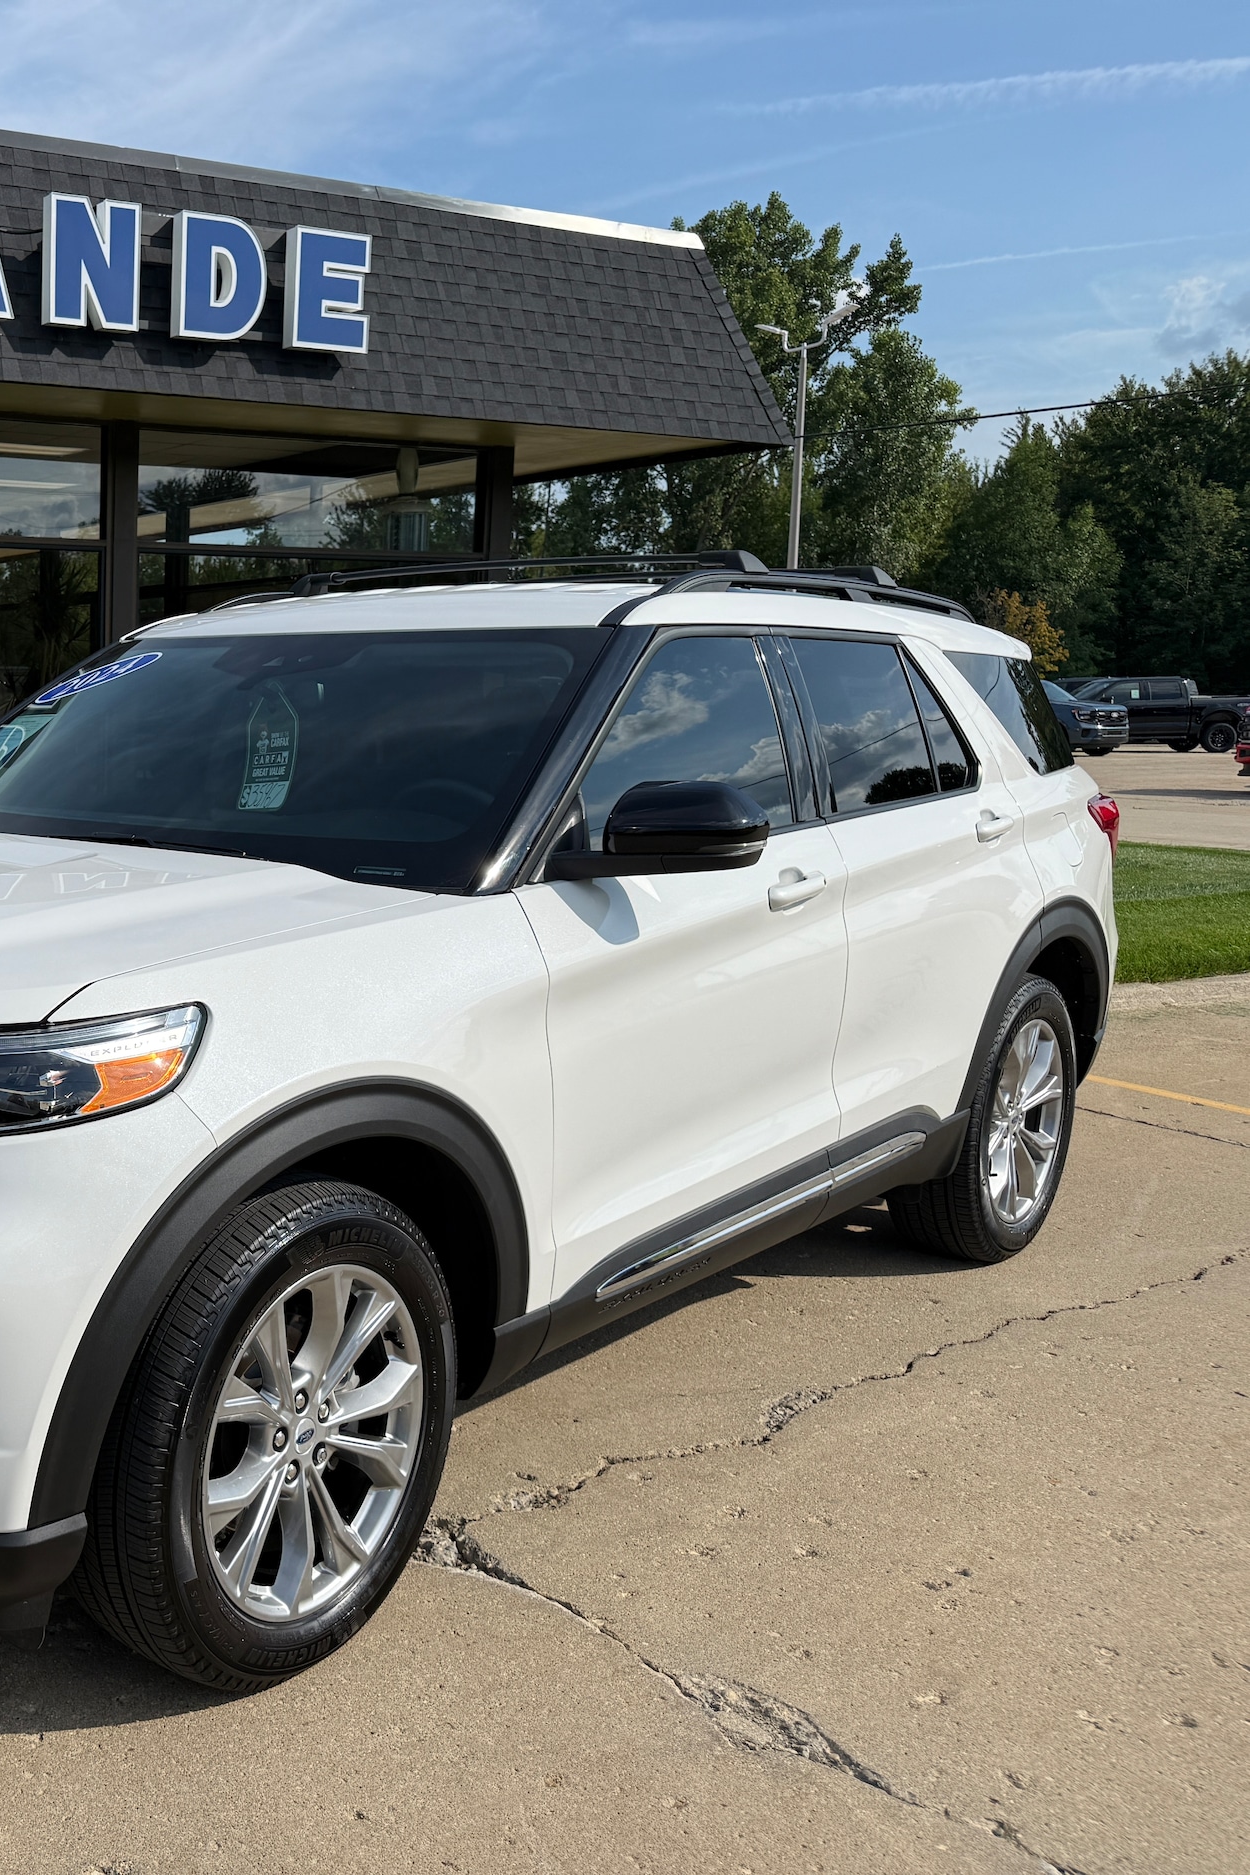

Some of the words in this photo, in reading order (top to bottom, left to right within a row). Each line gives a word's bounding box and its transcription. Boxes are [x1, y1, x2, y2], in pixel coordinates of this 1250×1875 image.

[271, 737, 290, 748] CARFAX
[254, 753, 288, 765] CARFAX
[252, 768, 269, 777] GREAT
[269, 766, 286, 776] VALUE
[90, 1034, 177, 1057] EXPLOR
[327, 1226, 405, 1254] MICHELIN
